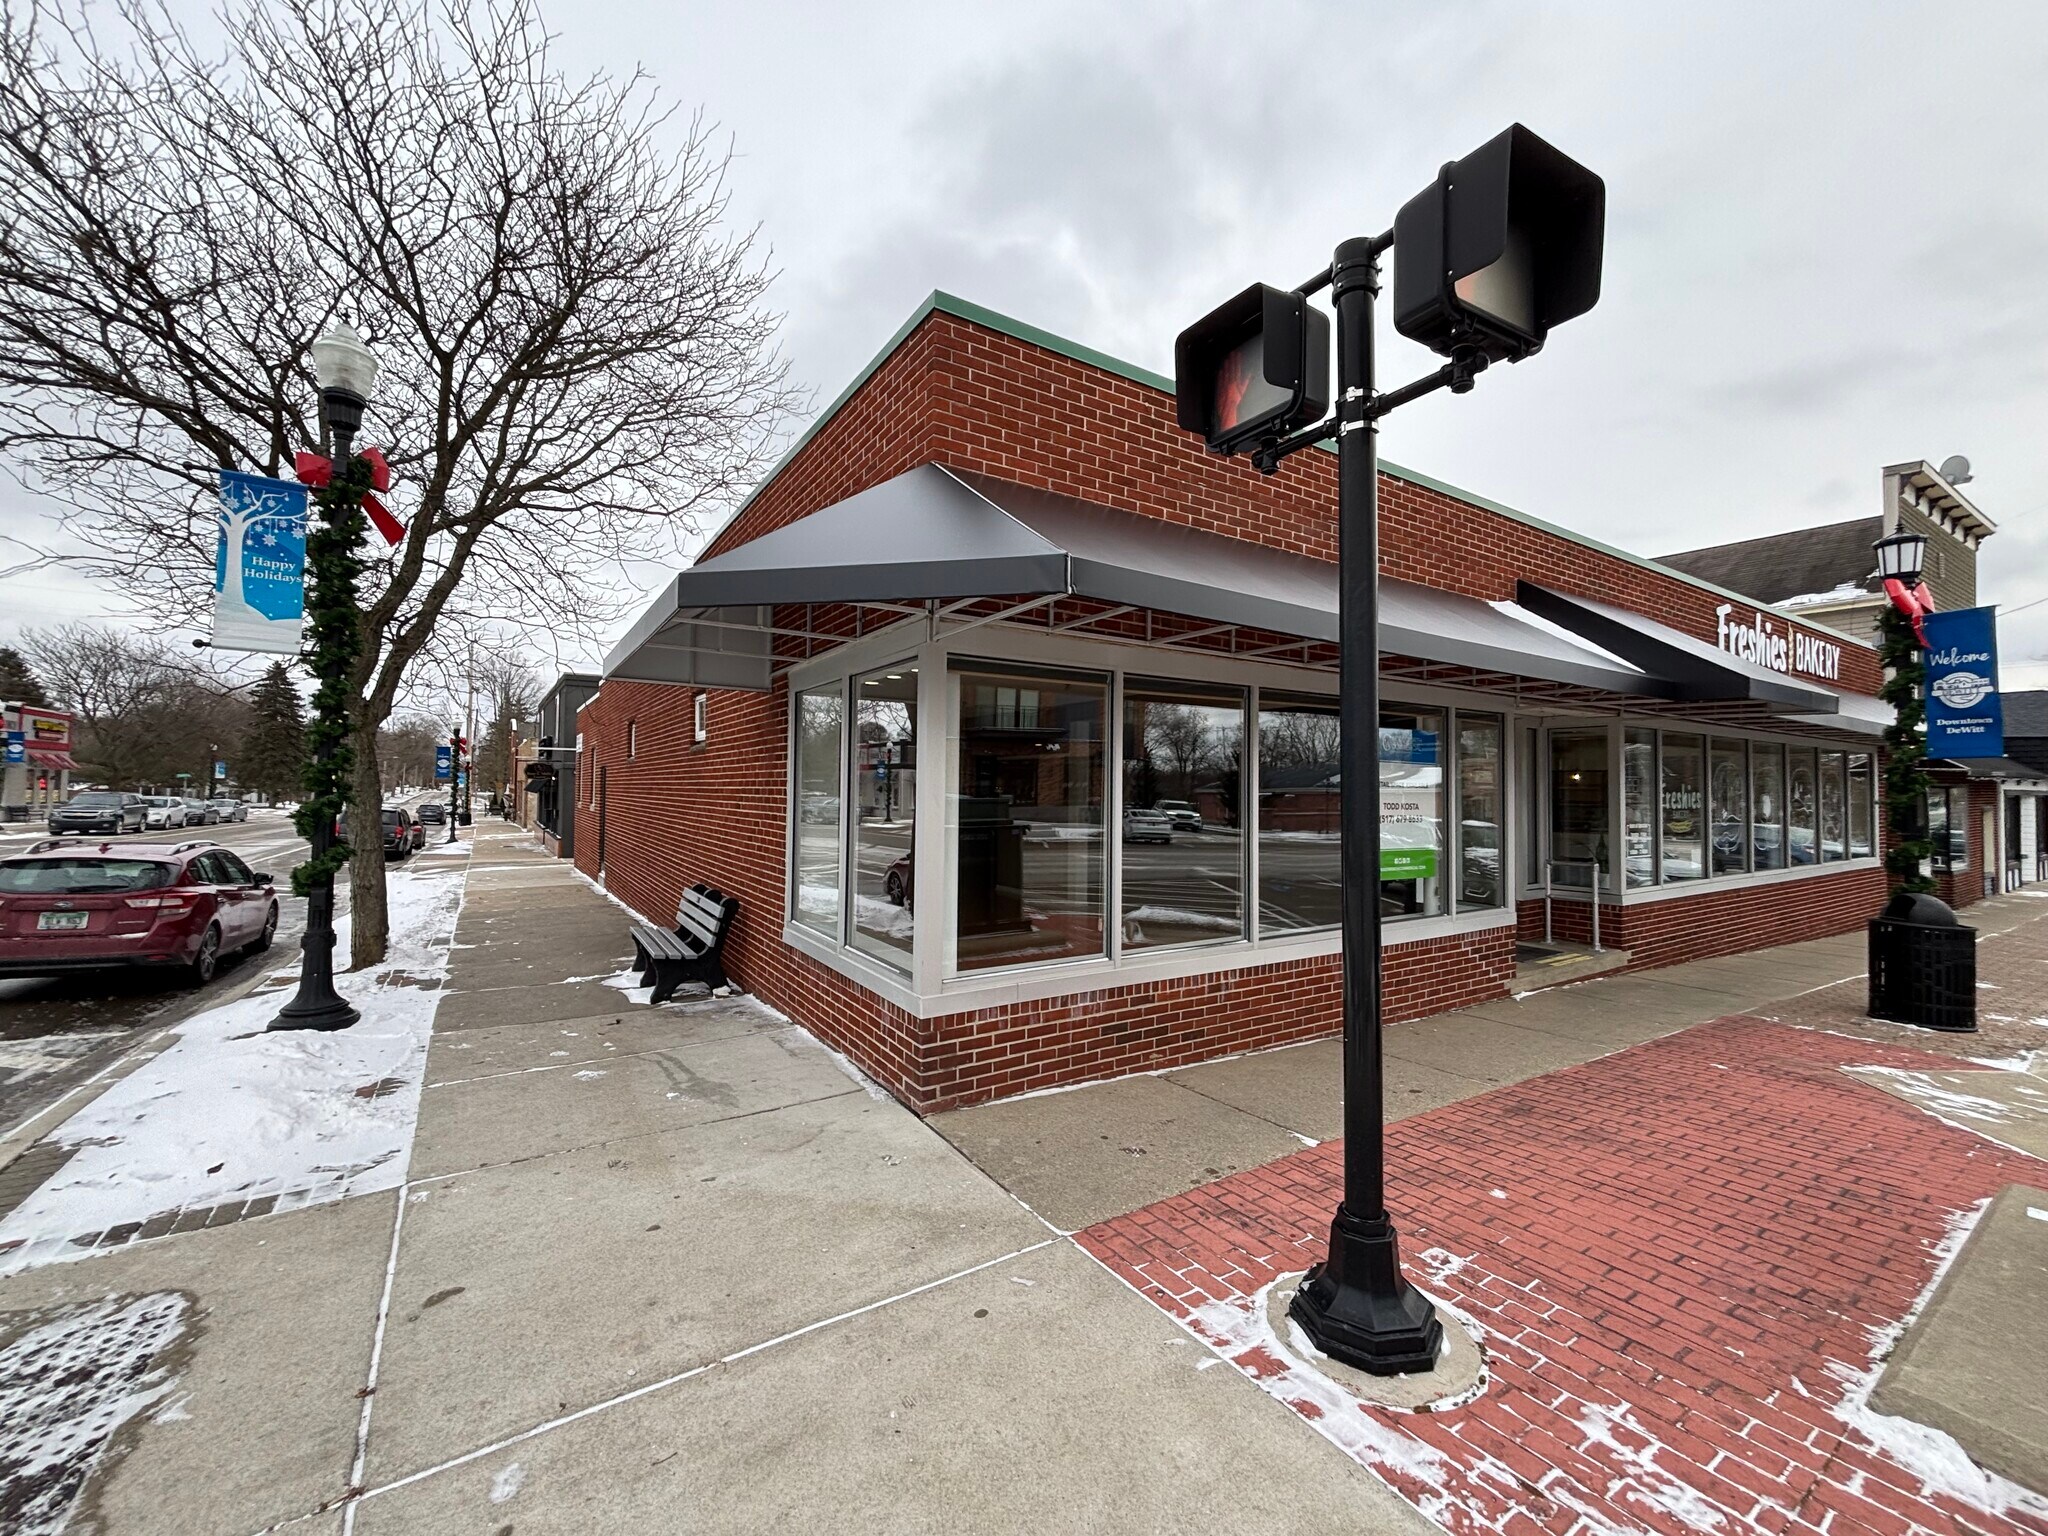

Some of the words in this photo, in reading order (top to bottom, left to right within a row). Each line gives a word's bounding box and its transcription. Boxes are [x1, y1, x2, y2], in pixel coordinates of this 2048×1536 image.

[252, 556, 296, 571] Happy
[243, 568, 302, 584] Holidays
[1716, 603, 1787, 672] Freshies
[1795, 632, 1841, 680] BAKERY
[1929, 647, 1990, 667] Welcome
[1936, 718, 1993, 727] Downtown
[1946, 725, 1985, 735] DeWitt
[1383, 803, 1400, 811] TODD
[1400, 803, 1420, 811] KOSTA
